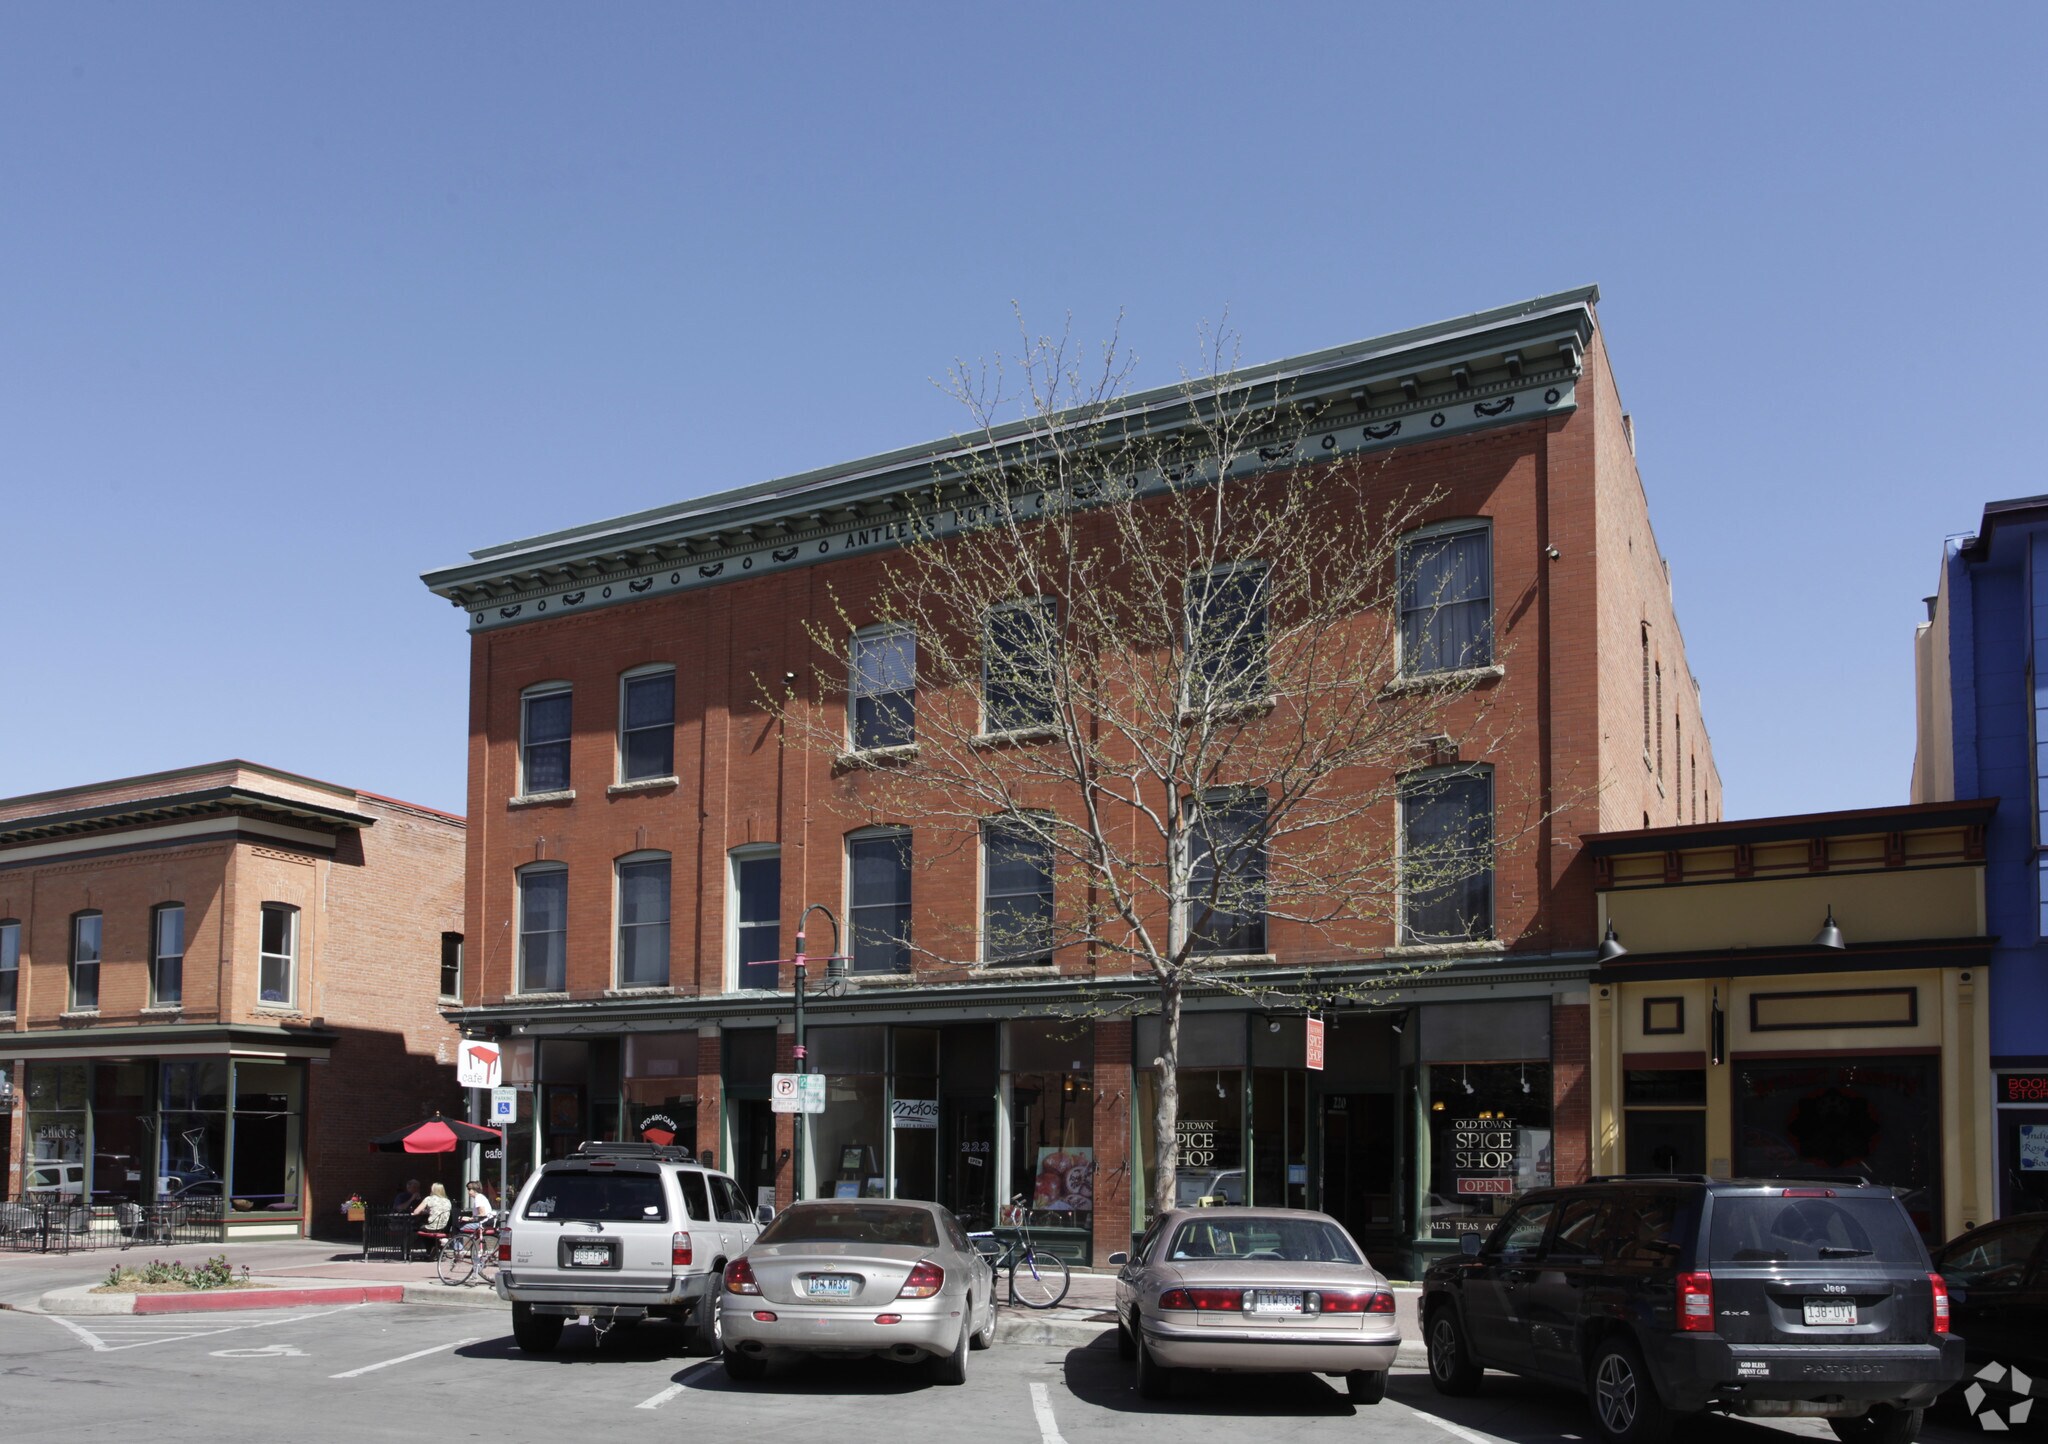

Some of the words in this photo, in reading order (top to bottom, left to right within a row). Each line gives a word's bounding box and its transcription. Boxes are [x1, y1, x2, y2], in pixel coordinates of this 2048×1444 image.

[845, 516, 935, 549] ANTLERS
[953, 502, 1018, 526] HOTEL
[462, 1072, 483, 1084] cafe
[640, 1114, 677, 1131] 970-490-CAFE
[1186, 1122, 1214, 1130] TOWN
[1455, 1120, 1477, 1129] OLD
[1477, 1120, 1512, 1129] TOWN
[961, 1141, 990, 1152] 222
[1176, 1132, 1214, 1149] PICE
[1456, 1132, 1513, 1149] SPICE
[485, 1148, 502, 1159] cafe
[1176, 1150, 1214, 1166] HOP
[1456, 1151, 1513, 1169] SHOP
[1464, 1180, 1505, 1192] OPEN
[1425, 1222, 1451, 1230] SALTS
[1823, 1284, 1847, 1294] Jeep
[1803, 1364, 1885, 1373] PATRIOT
